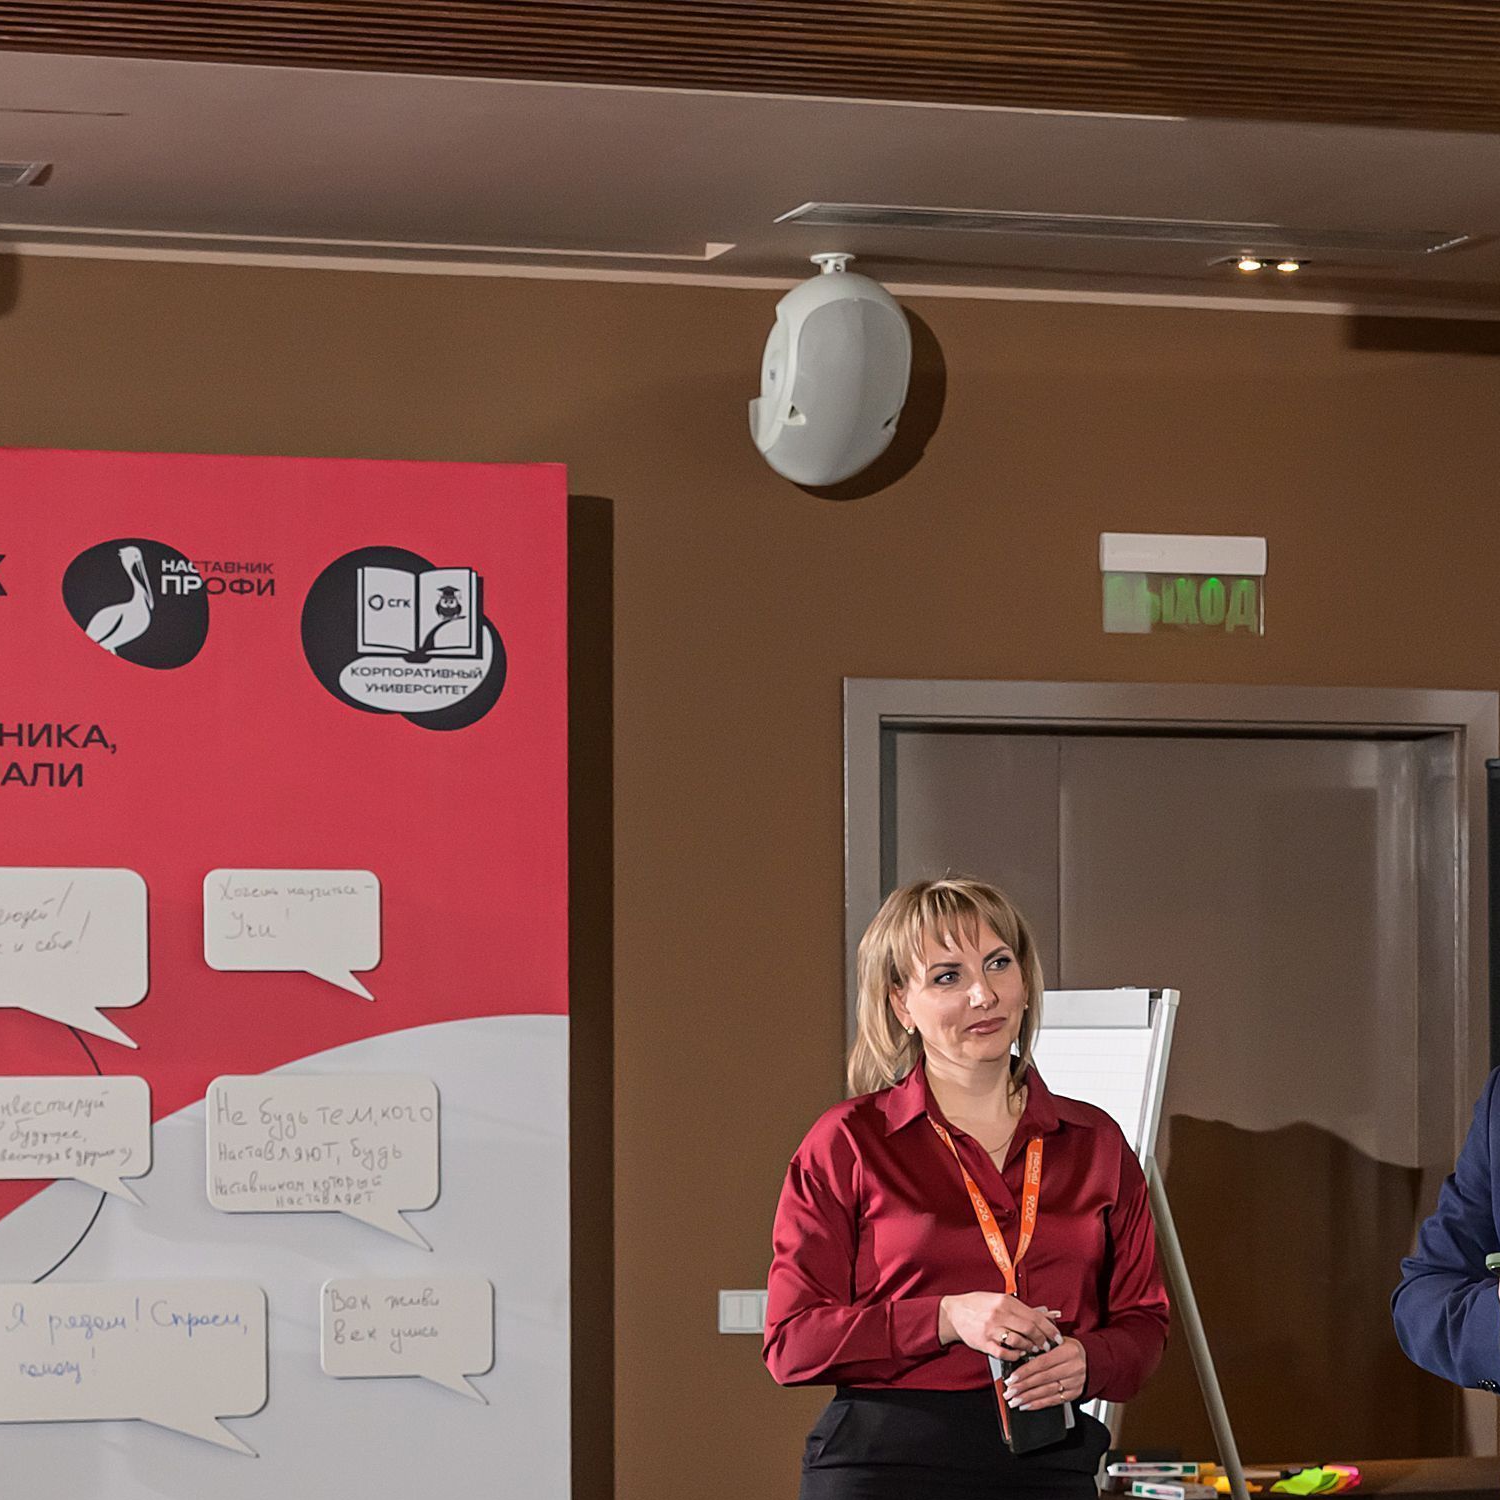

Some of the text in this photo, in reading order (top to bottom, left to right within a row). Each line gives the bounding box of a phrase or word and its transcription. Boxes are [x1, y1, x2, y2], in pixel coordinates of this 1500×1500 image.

[161, 559, 273, 575] НАСТАВНИК
[161, 574, 275, 597] ПРОФИ
[387, 597, 411, 609] СГК
[1104, 576, 1258, 634] ЫХОД
[350, 666, 484, 680] КОРПОРАТИВНЫЙ
[364, 683, 469, 696] УНИВЕРСИТЕТ
[1025, 1194, 1036, 1223] 2026
